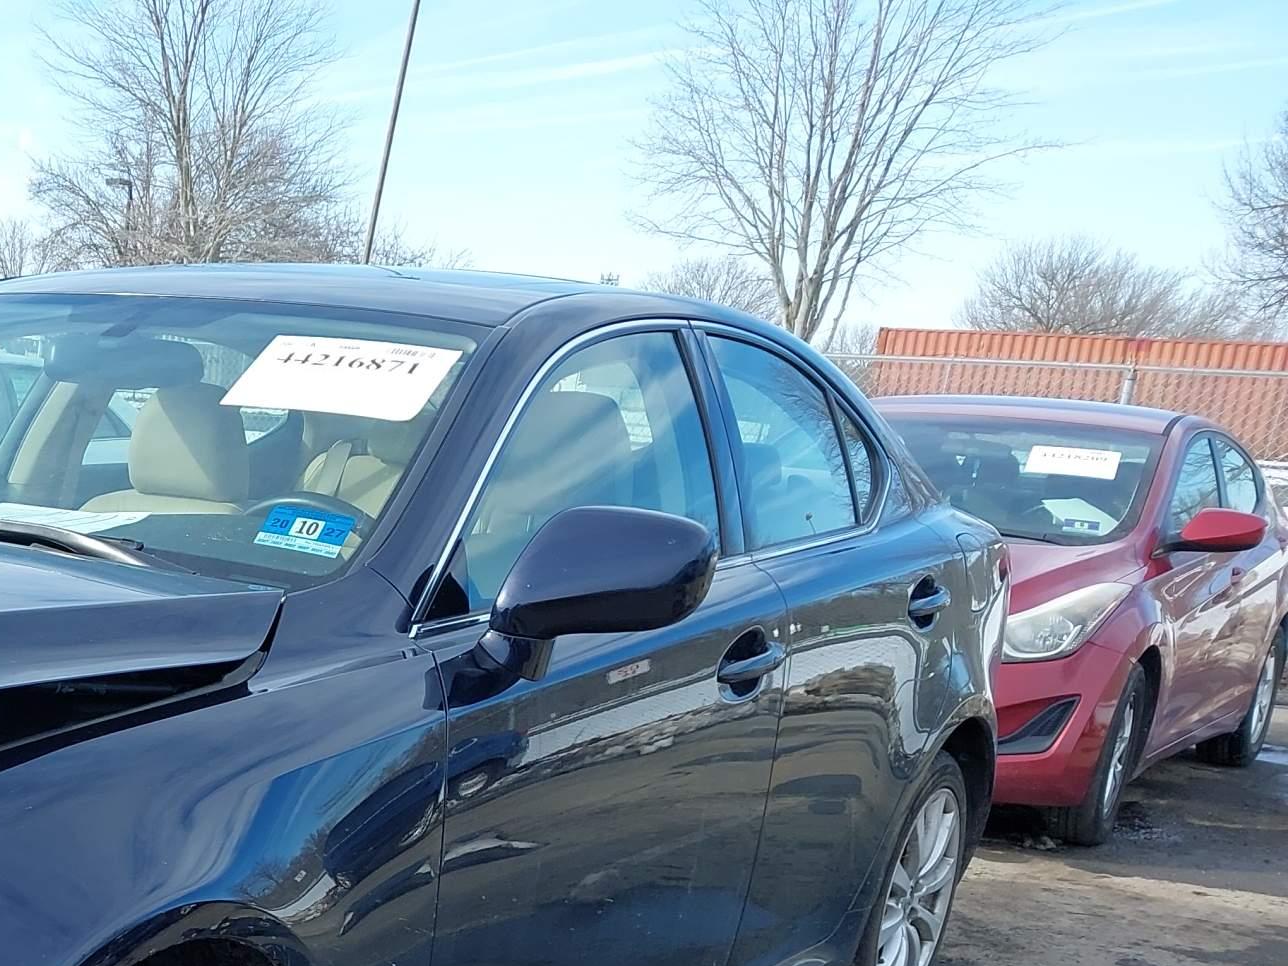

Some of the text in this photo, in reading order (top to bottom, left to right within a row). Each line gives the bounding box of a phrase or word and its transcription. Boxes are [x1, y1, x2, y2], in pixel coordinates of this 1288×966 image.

[277, 352, 420, 375] 44216871
[271, 518, 345, 538] 20 10 27
